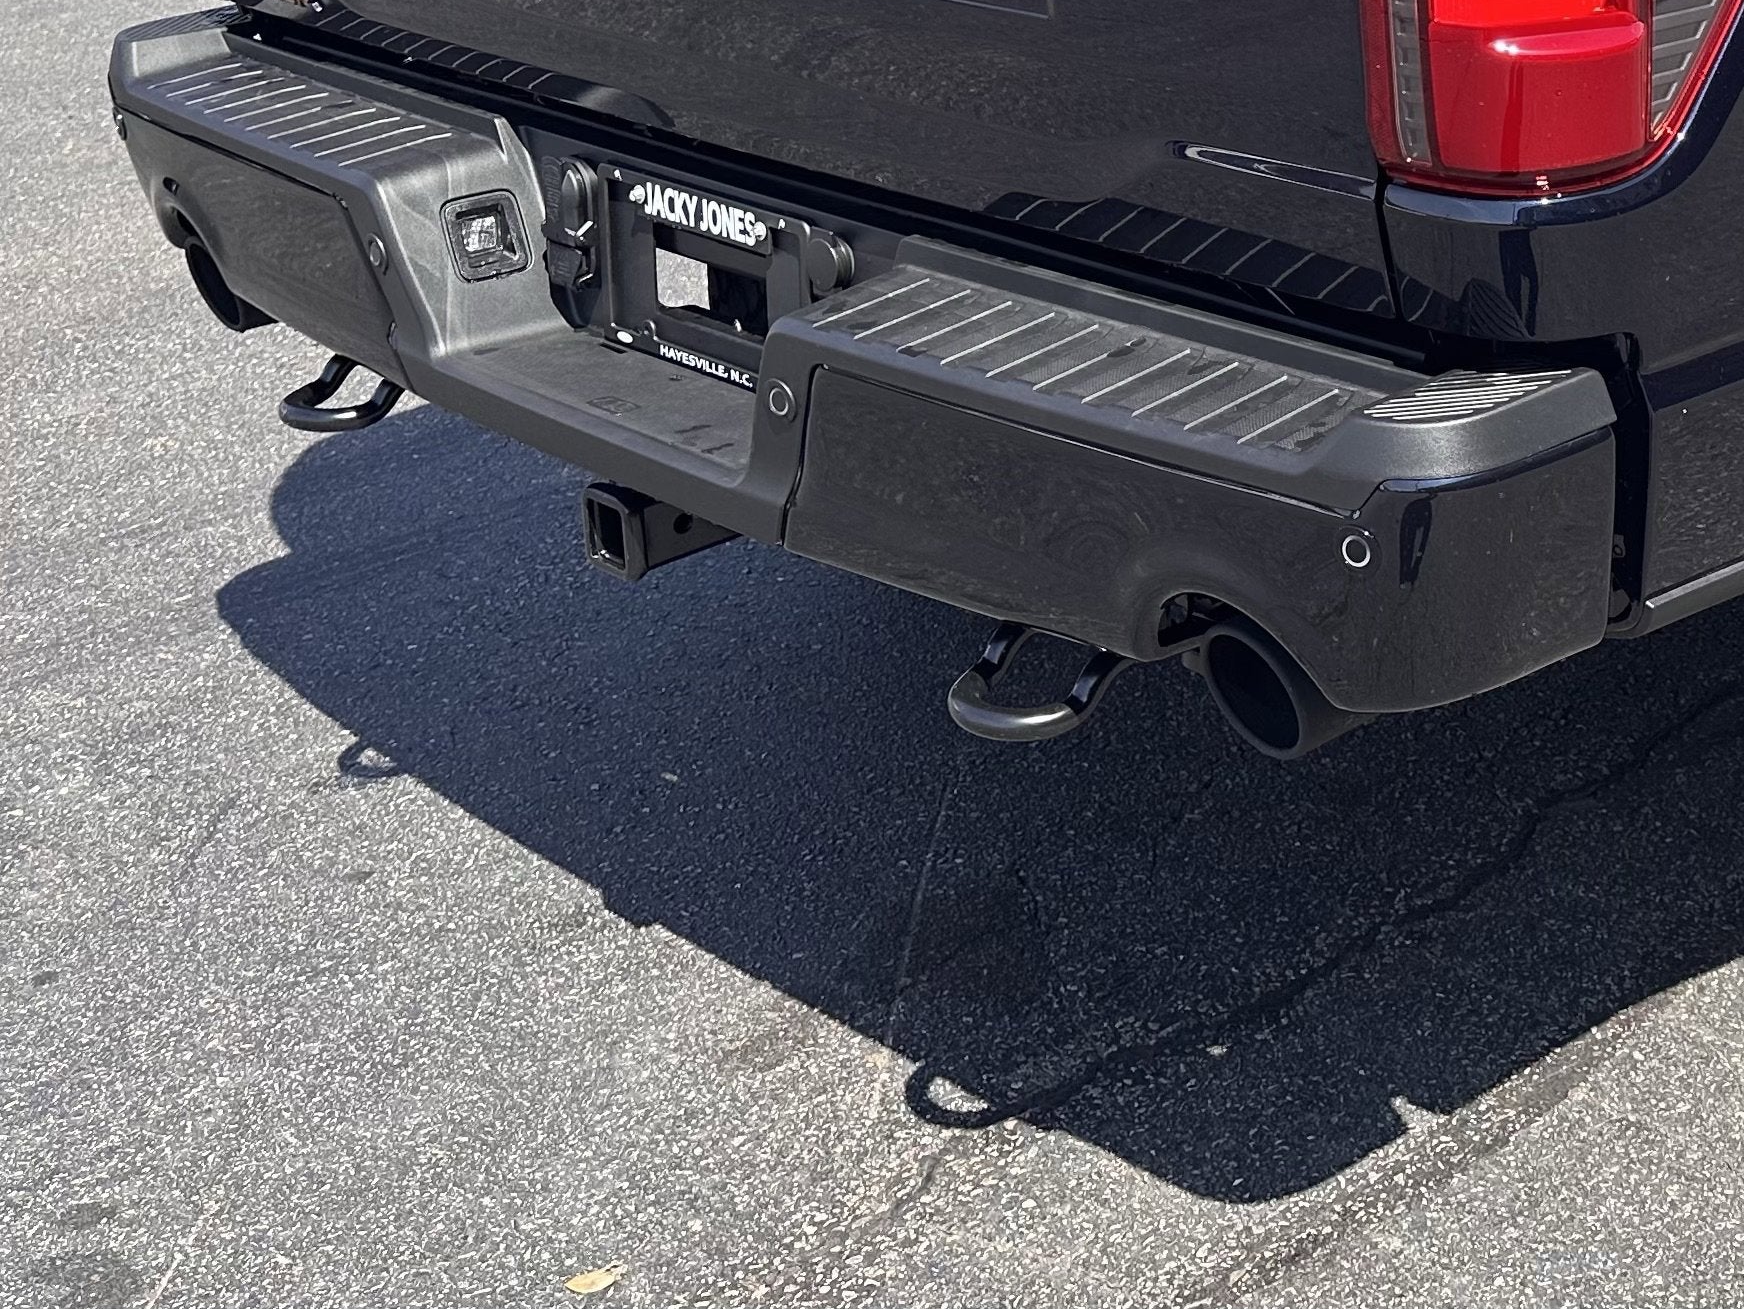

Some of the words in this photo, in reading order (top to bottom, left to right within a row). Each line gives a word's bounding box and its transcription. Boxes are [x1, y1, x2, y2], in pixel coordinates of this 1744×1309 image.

[644, 182, 698, 228] JACKY
[700, 198, 757, 247] JONES
[659, 344, 728, 380] HAYESVILLE,
[730, 368, 754, 389] N.C.
